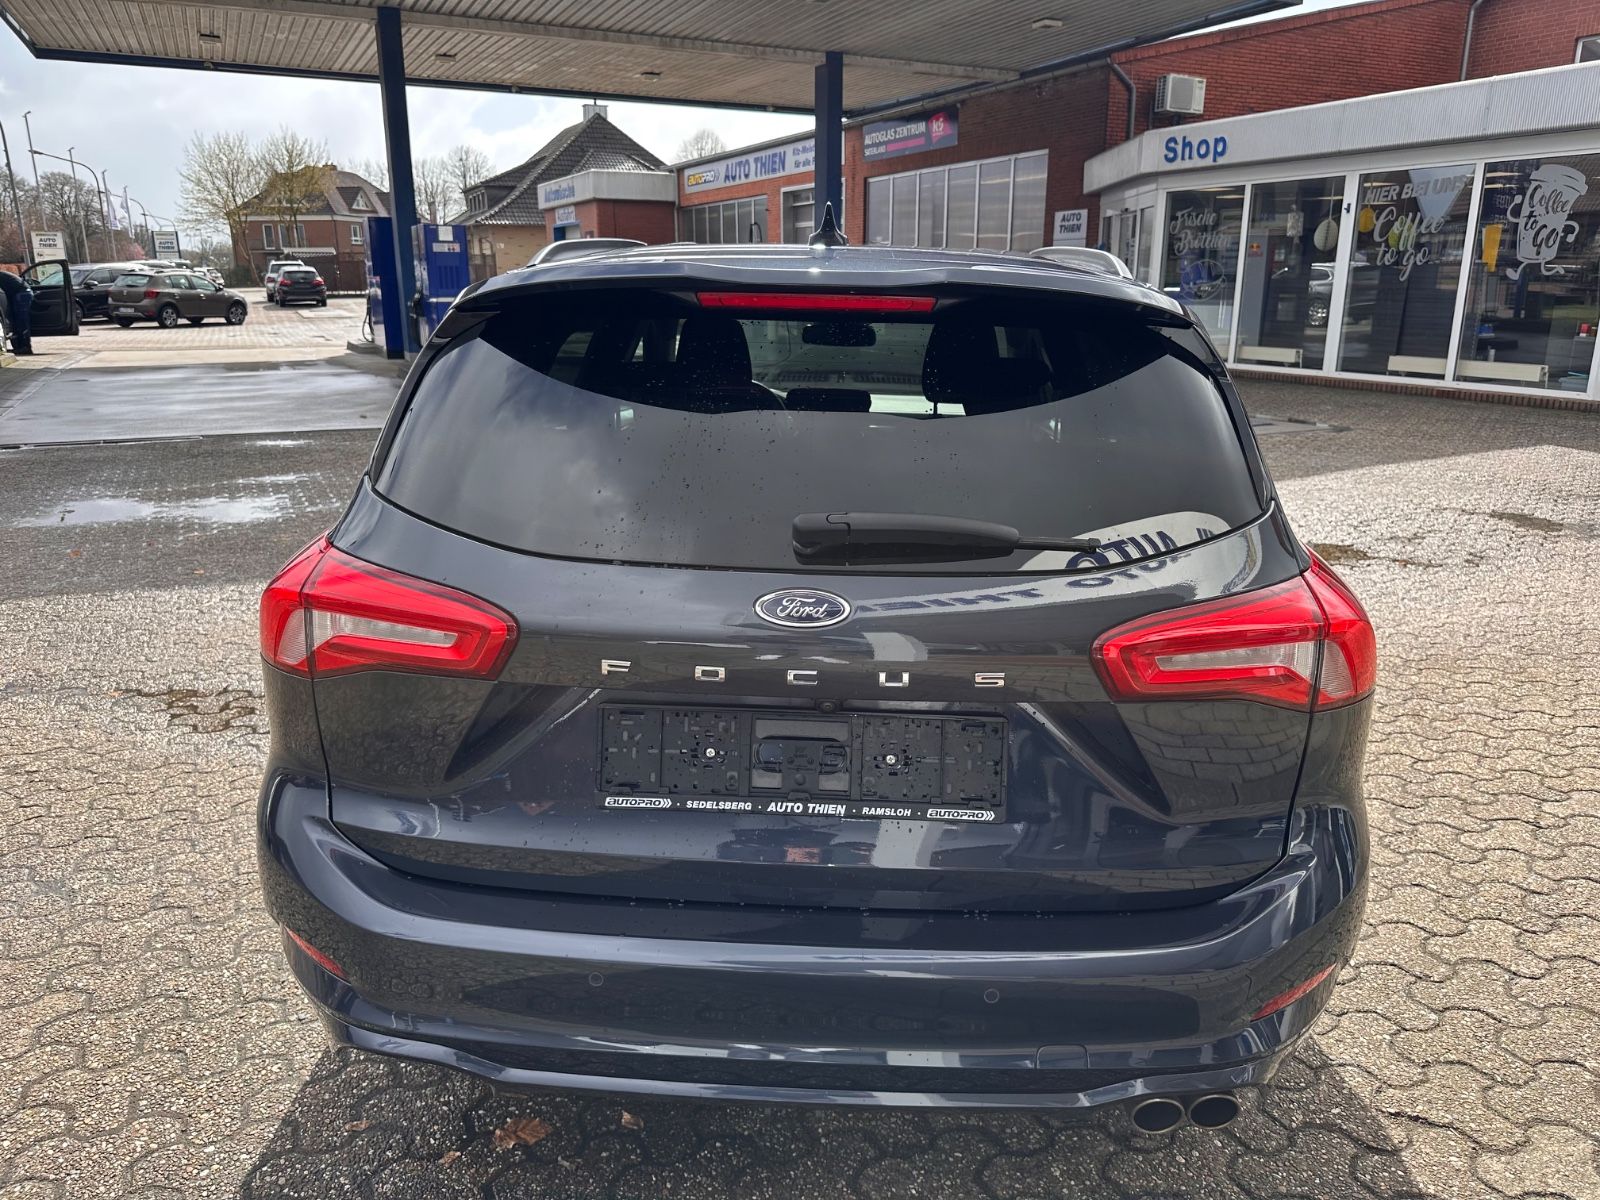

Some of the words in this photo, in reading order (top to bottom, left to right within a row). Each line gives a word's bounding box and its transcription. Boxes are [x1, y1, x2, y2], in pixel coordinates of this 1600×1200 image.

[864, 127, 895, 146] AUTOGLAS
[895, 121, 927, 139] ZENTRUM
[1164, 136, 1227, 163] Shop
[723, 158, 751, 184] AUTO
[753, 150, 786, 178] THIEN
[1364, 185, 1400, 205] HIER
[1528, 183, 1569, 214] Coffee
[1059, 223, 1082, 234] THIEN
[1061, 212, 1082, 223] AUTO
[1169, 206, 1218, 235] Frische
[1373, 206, 1446, 251] Coffee
[1521, 209, 1538, 232] to
[1376, 242, 1398, 266] to
[1399, 247, 1430, 282] go
[776, 596, 829, 618] Ford
[601, 659, 1006, 687] FOCUS
[686, 800, 752, 811] SEDELSBERG
[767, 802, 803, 813] AUTO
[807, 803, 847, 817] THIEN
[862, 807, 913, 817] RAMSLOH
